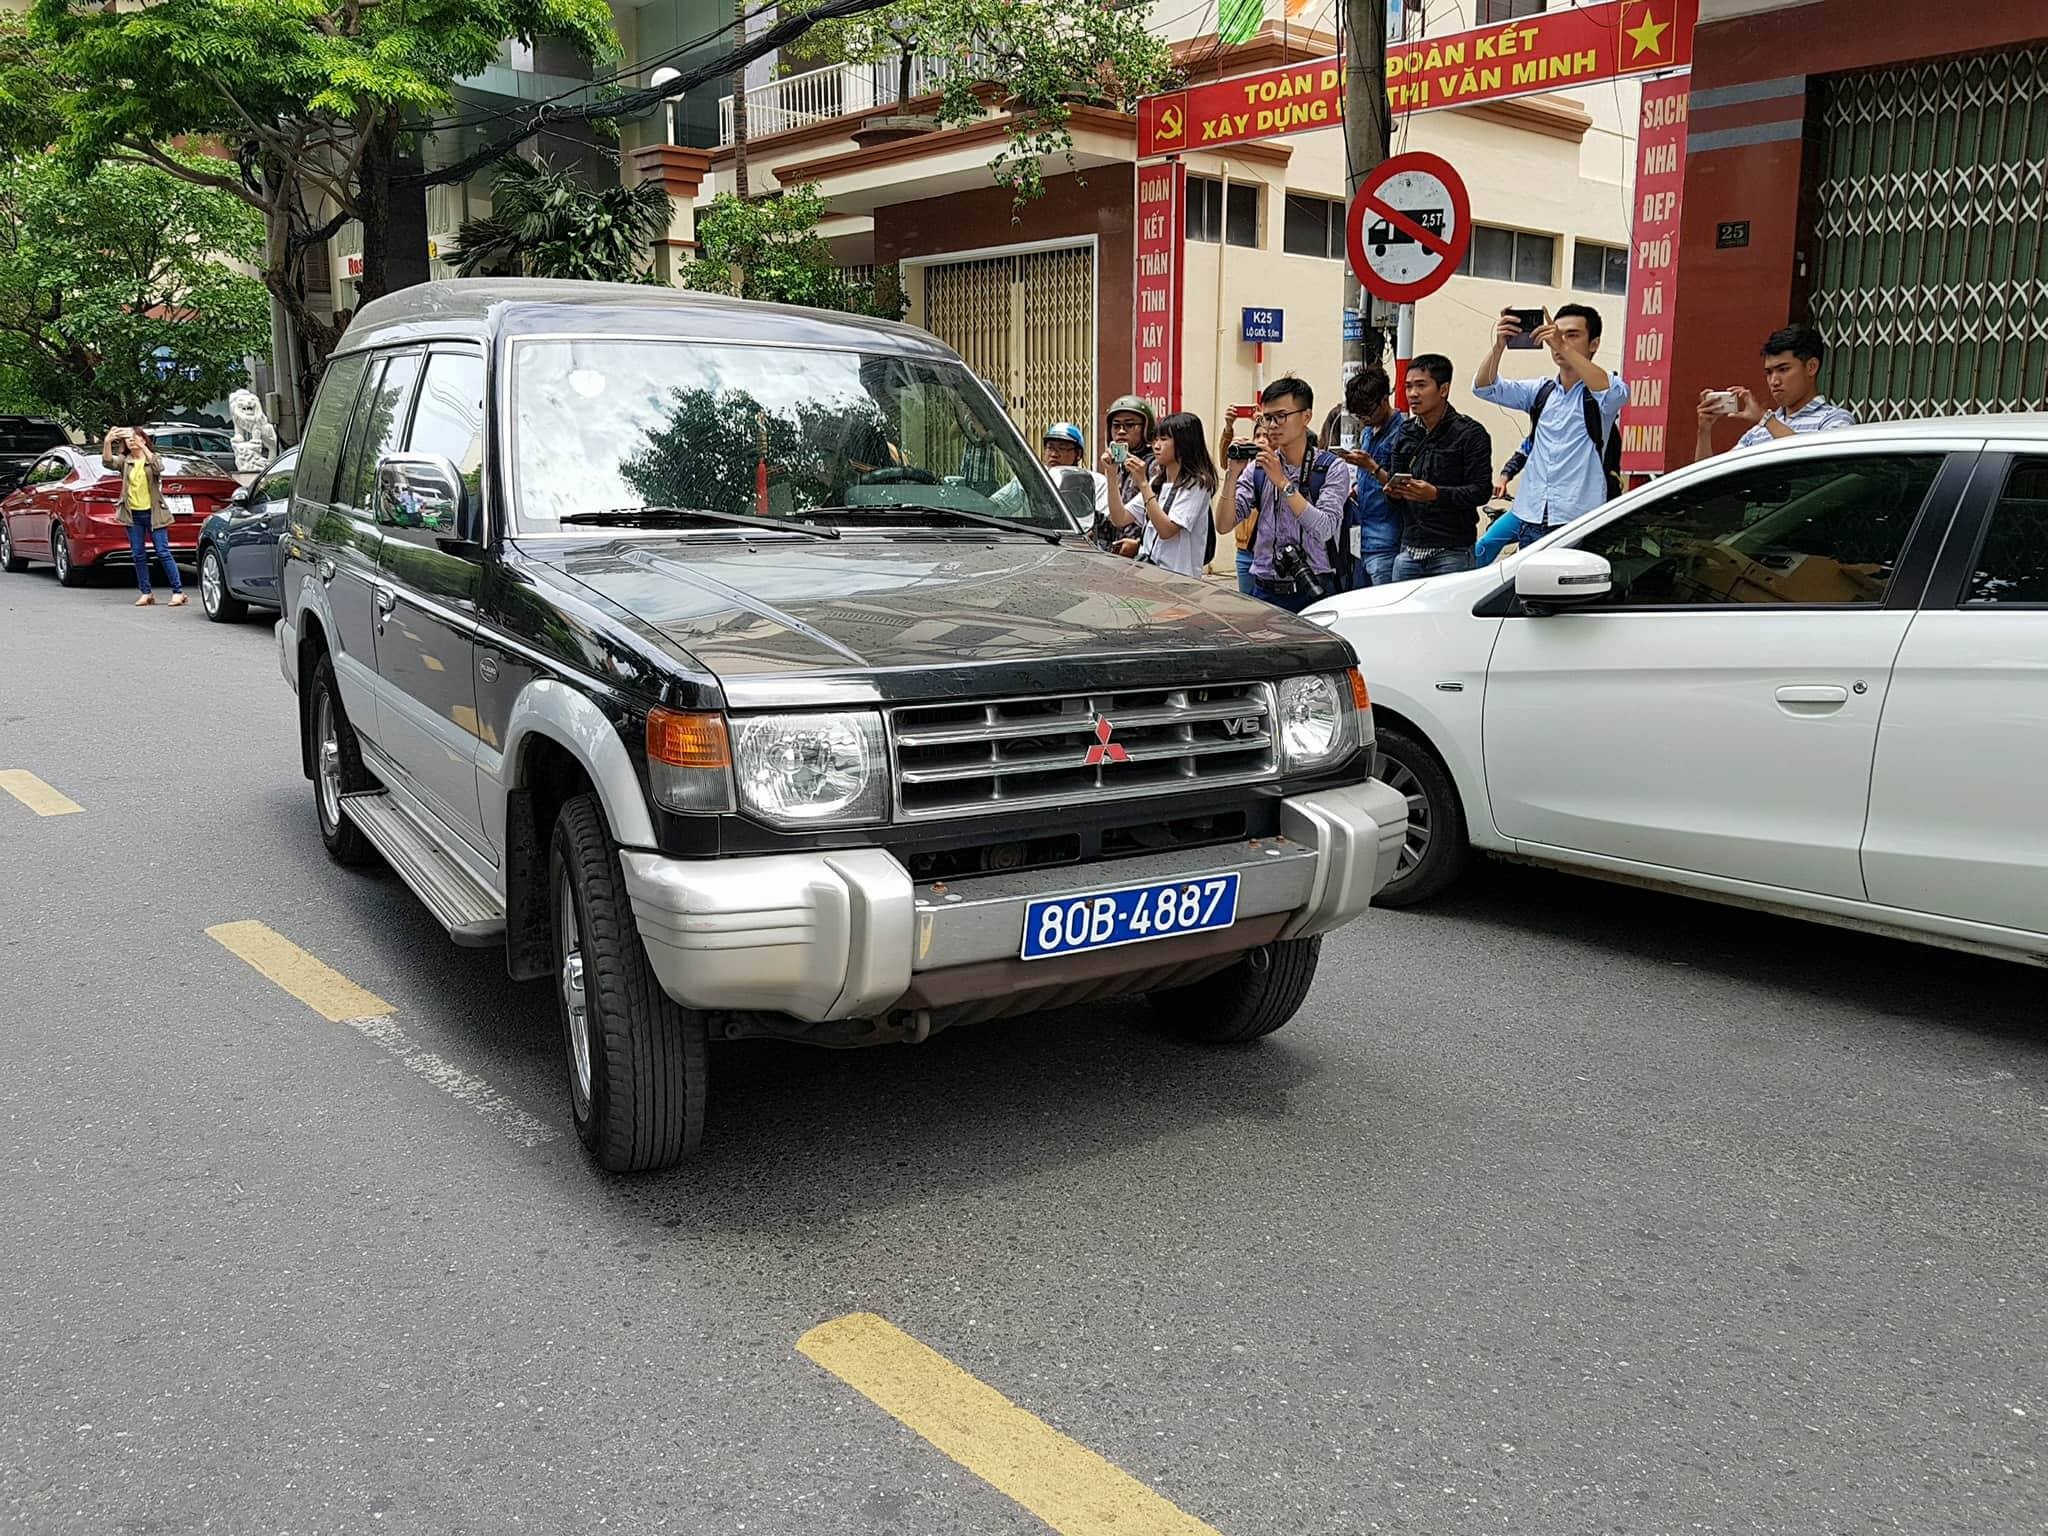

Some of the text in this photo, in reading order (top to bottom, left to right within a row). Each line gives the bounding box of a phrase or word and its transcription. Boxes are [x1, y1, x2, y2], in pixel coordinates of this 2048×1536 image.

[1244, 73, 1313, 105] TOÀN
[1385, 42, 1465, 78] ĐOÀN
[1475, 23, 1539, 60] KẾT
[1201, 112, 1250, 141] XÂY
[1257, 99, 1328, 132] DỰNG
[1385, 79, 1430, 108] THỊ
[1438, 67, 1501, 98] VĂN
[1512, 49, 1597, 85] MINH
[1643, 93, 1688, 131] SẠCH
[1644, 136, 1677, 176] NHÀ
[1143, 209, 1165, 241] KẾT
[1720, 224, 1745, 240] 25
[1140, 248, 1168, 277] THÂN
[1638, 230, 1676, 270] PHỐ
[1140, 286, 1166, 313] TÌNH
[1641, 280, 1663, 316] XÃ
[1253, 311, 1273, 324] K25
[1142, 321, 1163, 348] XÂY
[1634, 327, 1664, 367] HỘI
[1630, 375, 1662, 408] VĂN
[1621, 425, 1664, 453] MINH
[1222, 716, 1260, 735] V6
[1038, 880, 1228, 950] 80B-4887
